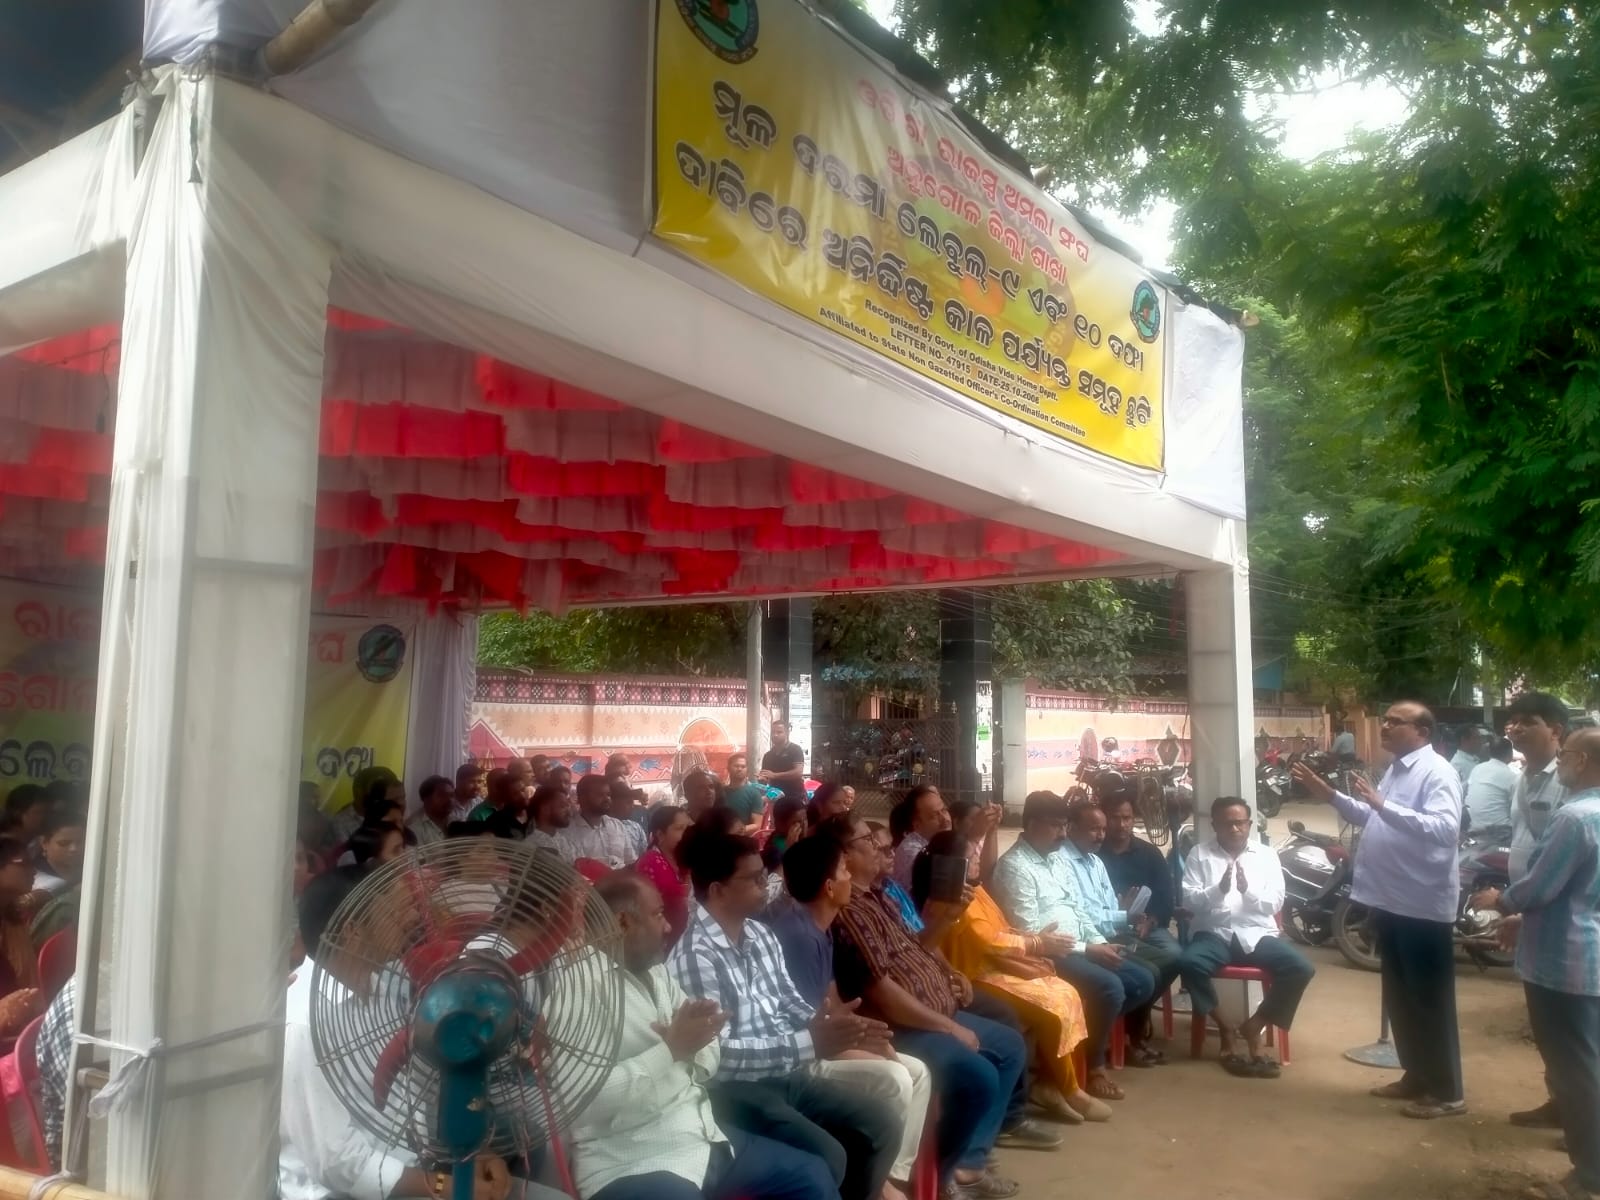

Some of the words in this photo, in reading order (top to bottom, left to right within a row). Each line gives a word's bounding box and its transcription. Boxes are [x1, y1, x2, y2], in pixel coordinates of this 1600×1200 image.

[713, 80, 777, 149] ମୂଳ
[793, 134, 886, 219] ଦରମା
[1028, 287, 1067, 324] ଏବଂ
[1074, 314, 1101, 347] ୧୦
[1108, 334, 1144, 372] ଦଫା
[988, 209, 1026, 263] ଜିଲ୍ଲା
[1030, 246, 1067, 285] ଶାଖା
[1003, 183, 1054, 236] ଅମଲା
[1058, 226, 1090, 263] ସଂଘ
[676, 141, 807, 250] ଦାବିରେ
[944, 299, 994, 348] କାଳ
[1078, 369, 1122, 415] ସମୂହ
[820, 307, 866, 337] Affiliated
[869, 332, 879, 343] to
[881, 338, 906, 357] State
[908, 350, 926, 365] Non
[928, 361, 964, 384] Gazetted
[967, 379, 998, 400] Officer's
[1000, 395, 1049, 422] Co-Ordination
[1050, 416, 1085, 436] Committee
[865, 299, 919, 333] Recognized
[921, 328, 933, 341] By
[959, 348, 968, 358] of
[970, 352, 996, 371] Odisha
[998, 365, 1015, 380] Vide
[1017, 375, 1037, 391] Home
[890, 328, 928, 351] LETTER
[946, 357, 971, 374] 47915
